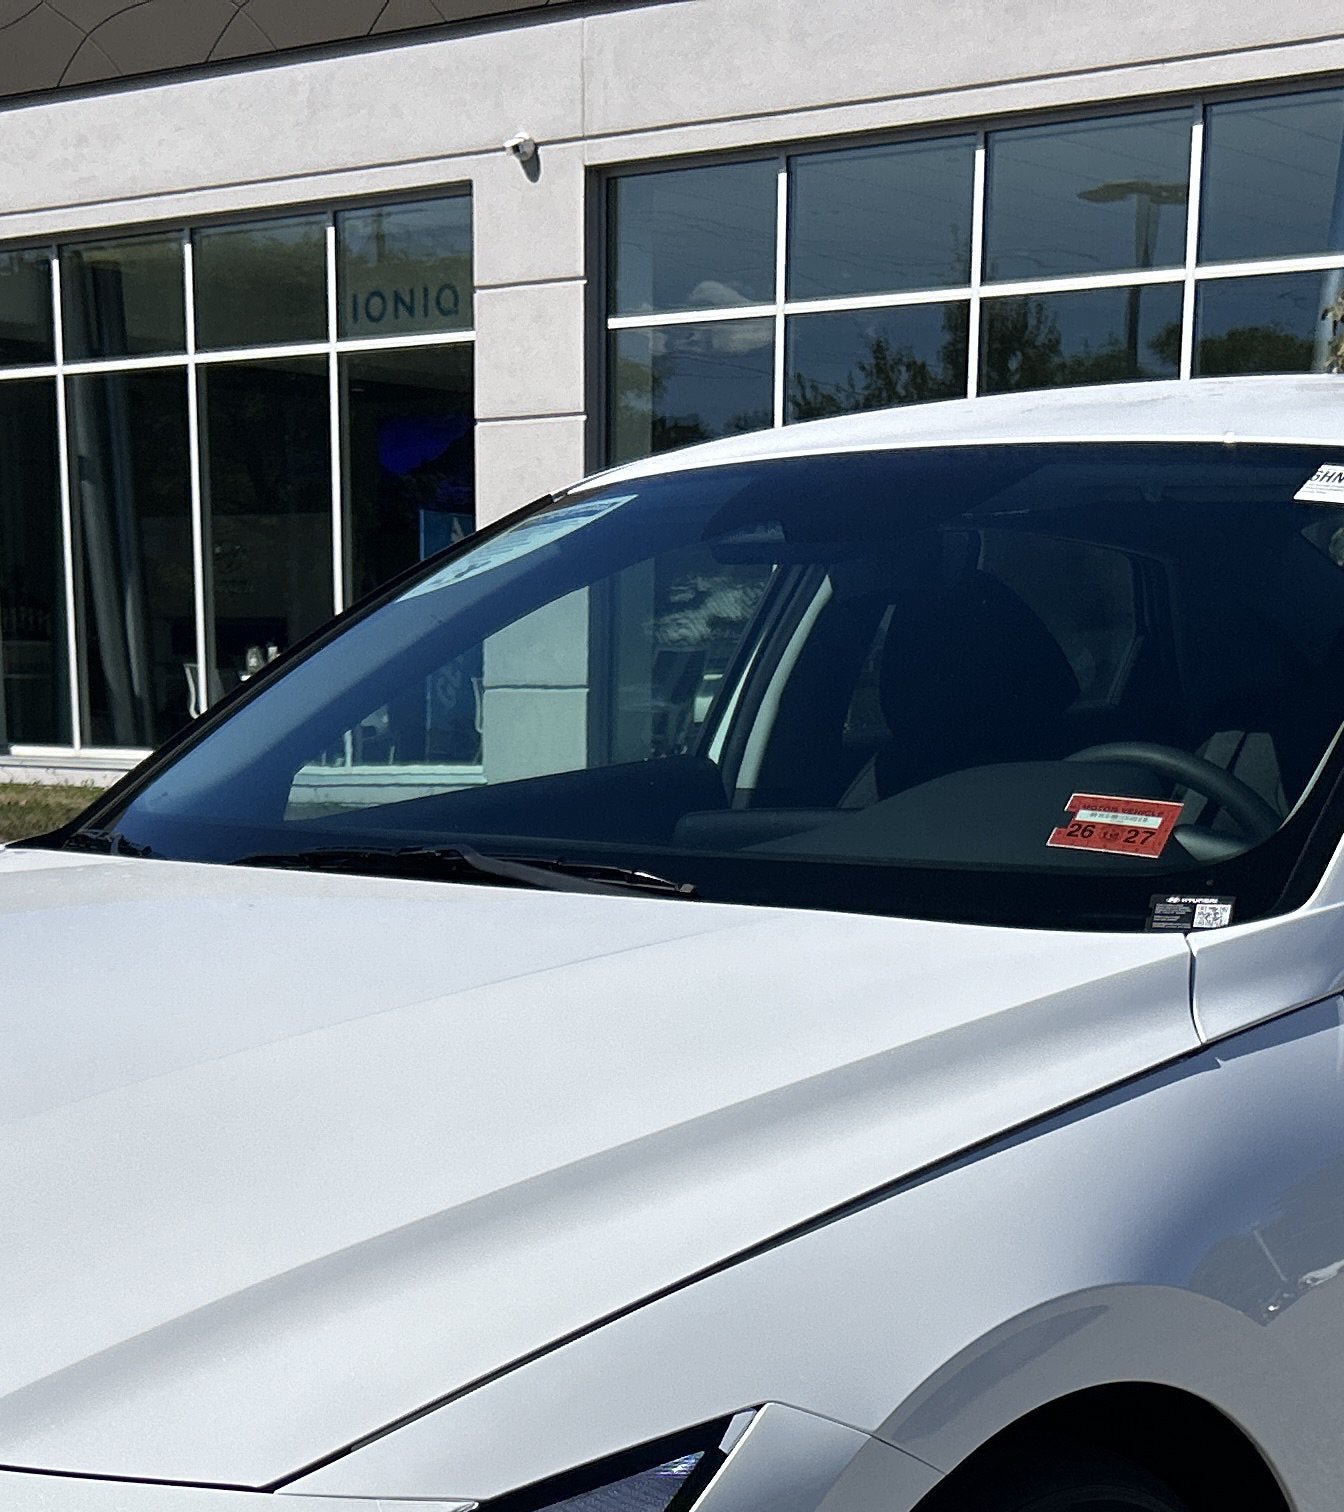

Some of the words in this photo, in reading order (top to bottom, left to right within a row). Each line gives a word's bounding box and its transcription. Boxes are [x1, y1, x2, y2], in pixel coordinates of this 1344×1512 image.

[352, 283, 460, 324] IONIQ
[1066, 823, 1096, 839] 26
[1123, 829, 1156, 845] 27
